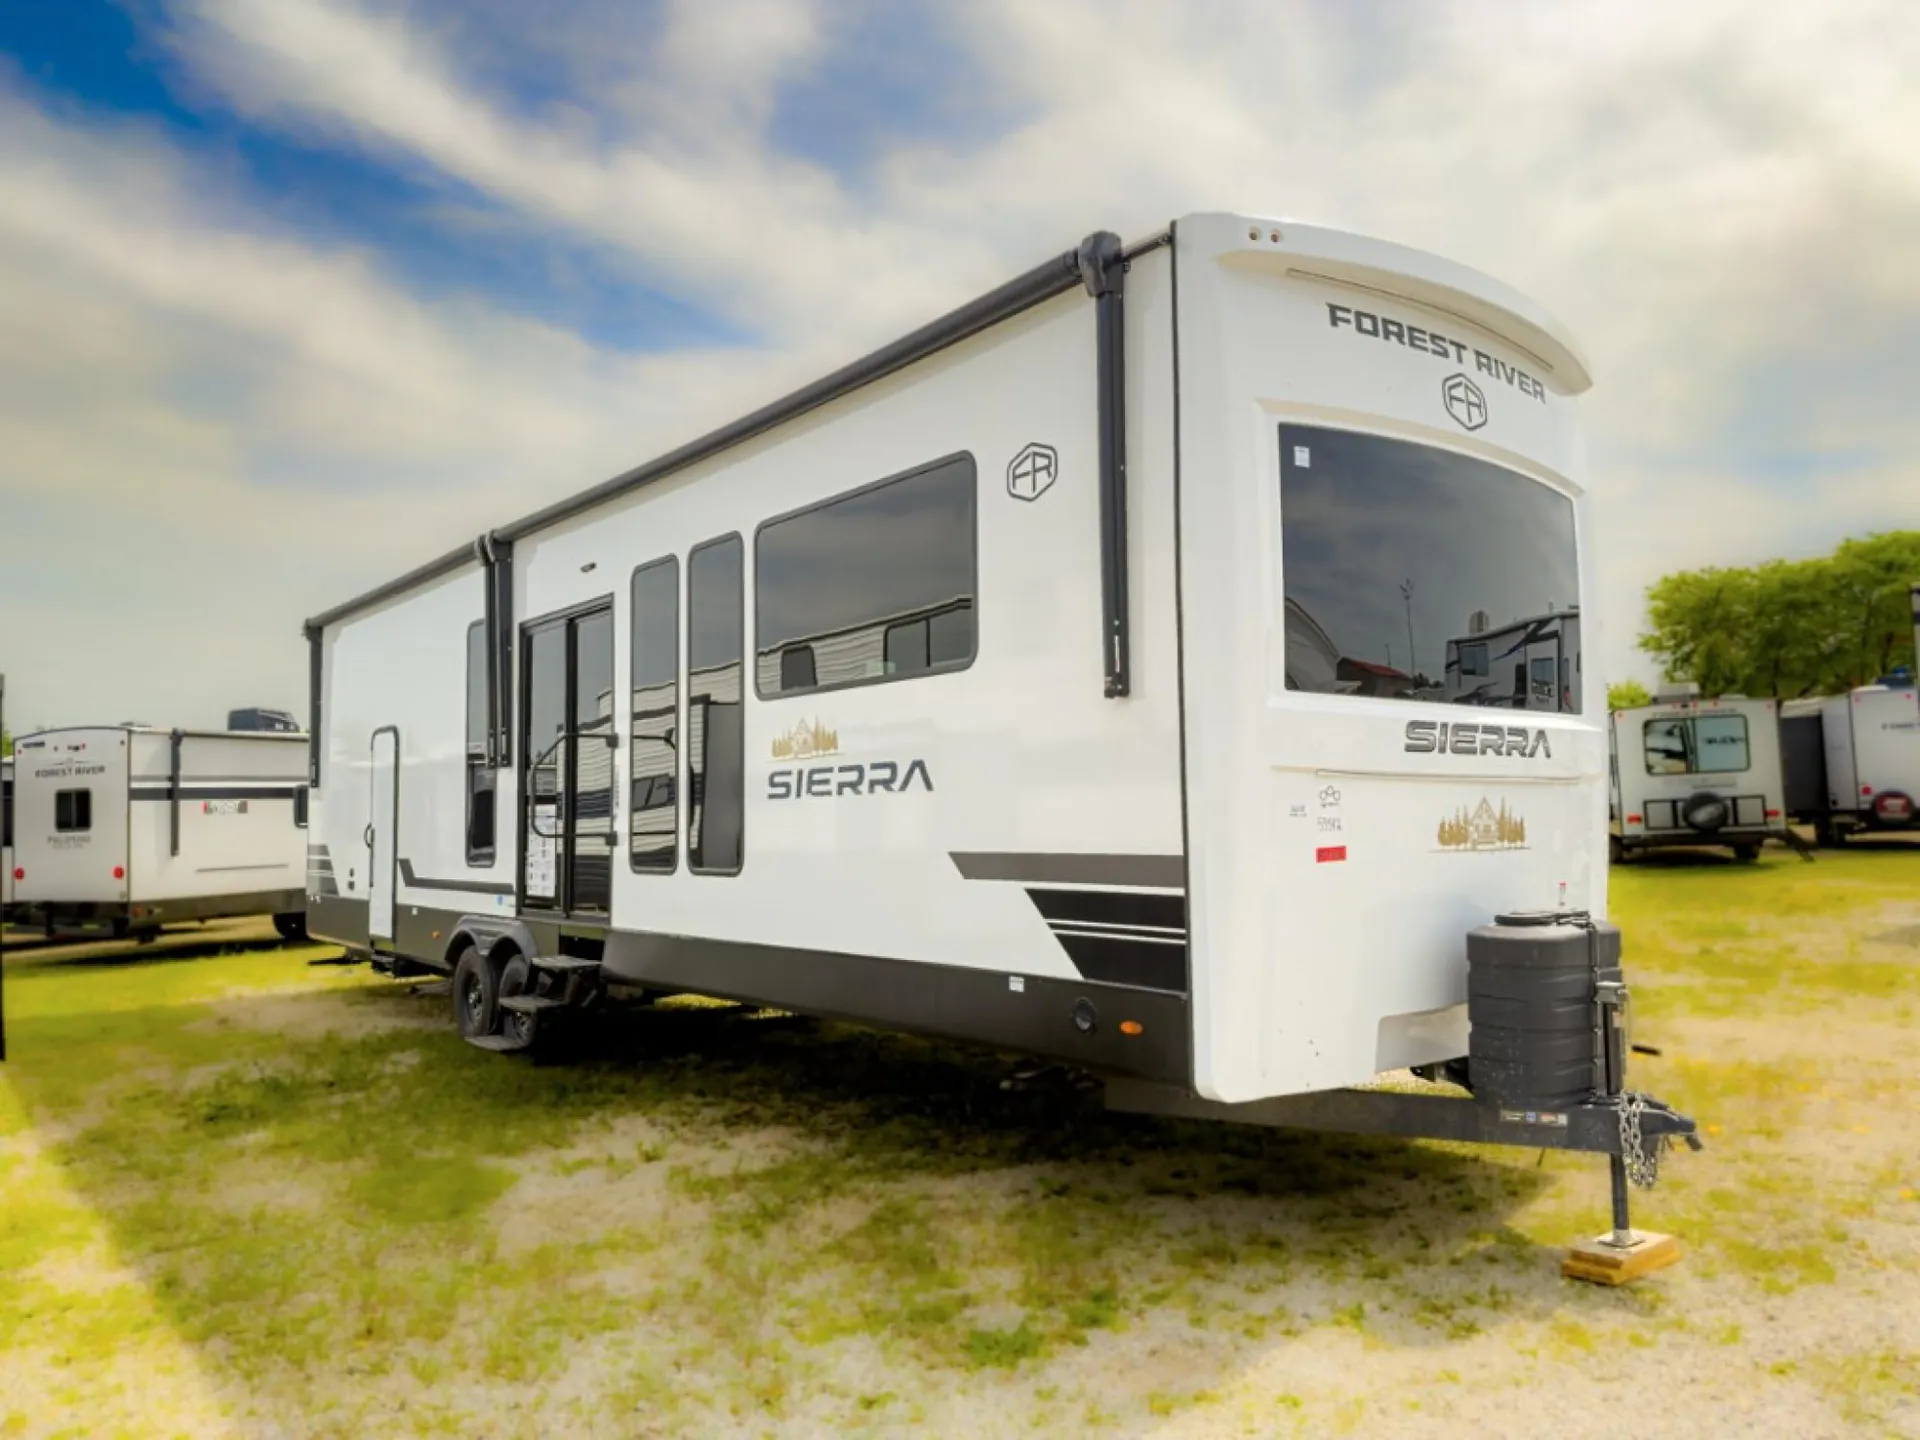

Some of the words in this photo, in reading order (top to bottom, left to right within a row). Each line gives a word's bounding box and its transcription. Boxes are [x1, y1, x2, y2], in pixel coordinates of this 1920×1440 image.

[1326, 302, 1467, 364] FOREST
[1472, 348, 1547, 404] RIVER
[1404, 719, 1552, 759] SIERRA
[75, 765, 106, 776] RIVER
[767, 759, 934, 800] SIERRA
